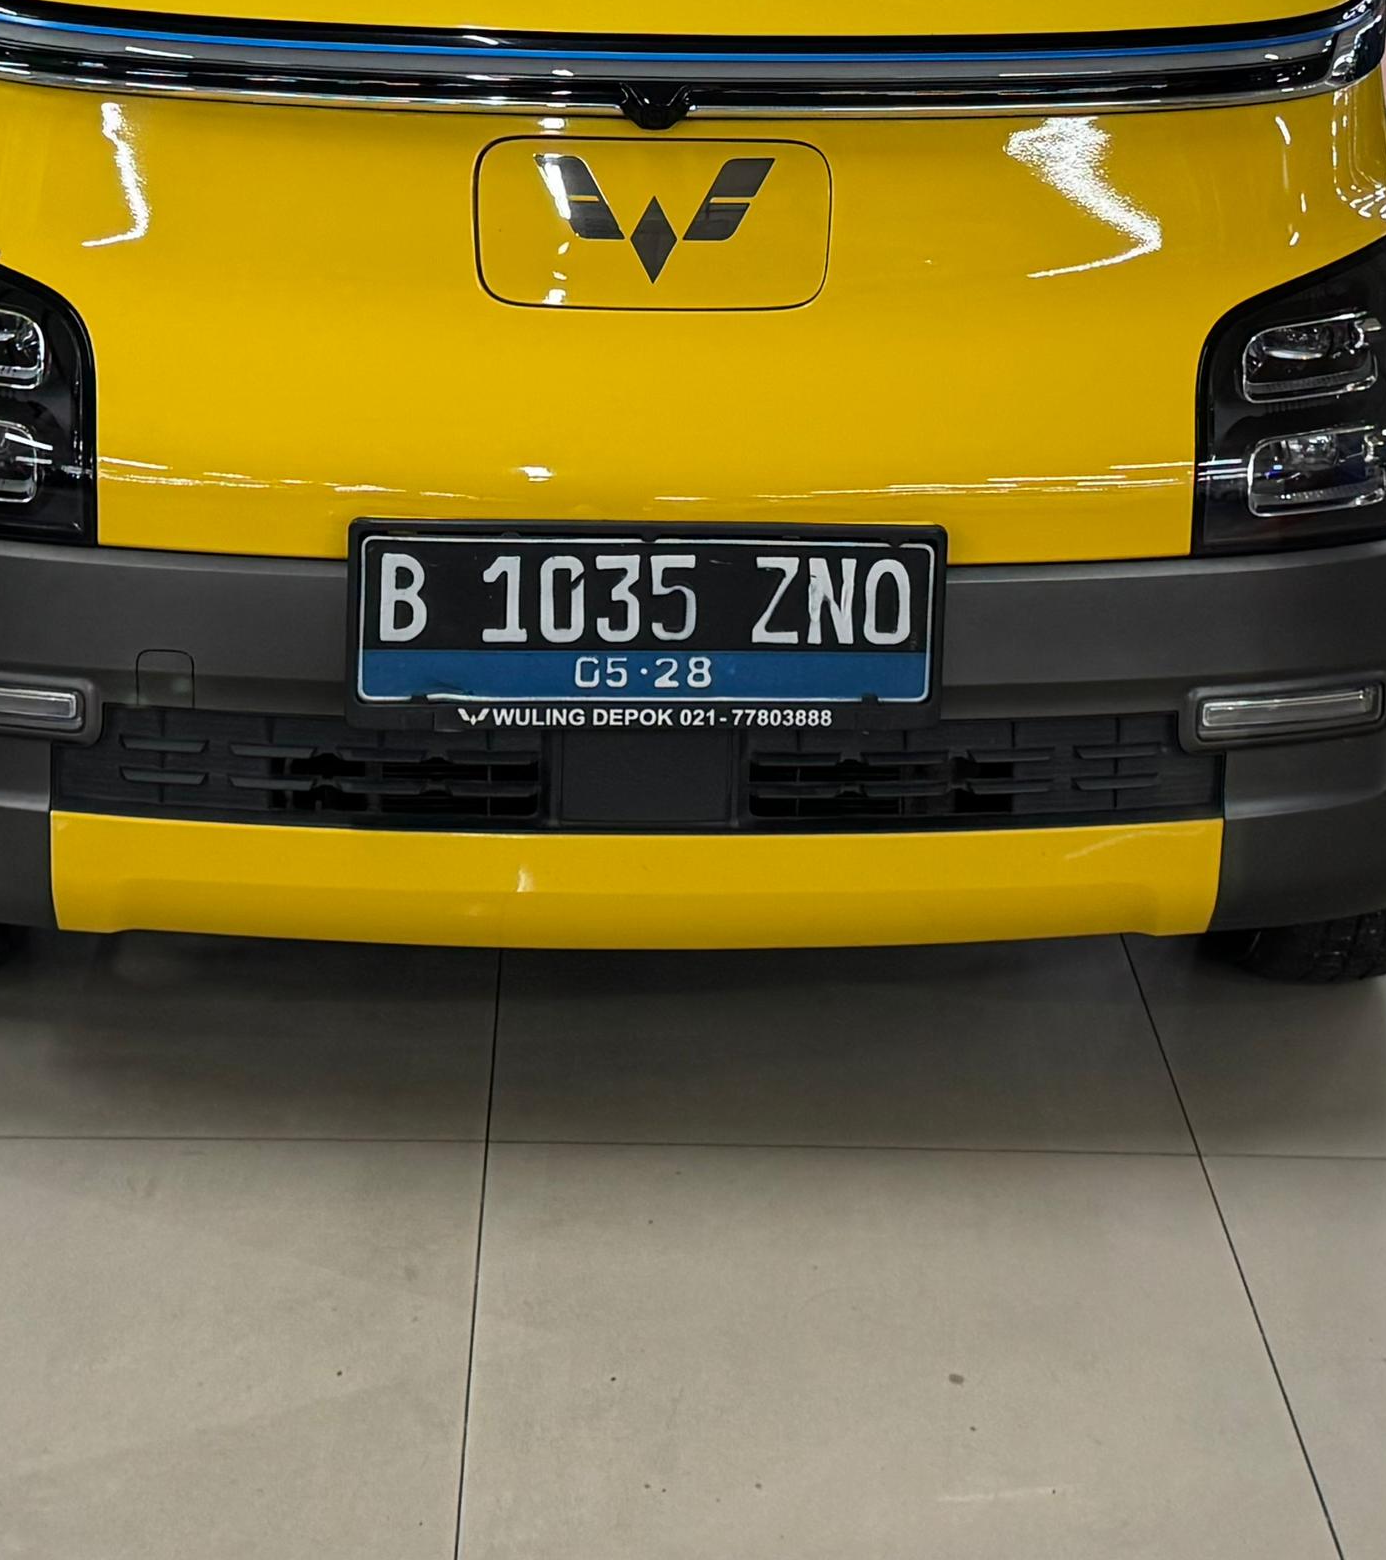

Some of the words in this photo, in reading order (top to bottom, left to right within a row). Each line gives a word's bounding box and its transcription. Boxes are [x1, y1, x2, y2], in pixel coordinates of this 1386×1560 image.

[379, 553, 427, 643] B
[482, 553, 697, 643] 1035
[751, 557, 911, 646] ZNO
[492, 708, 586, 726] WULING
[592, 708, 674, 726] DEPOK
